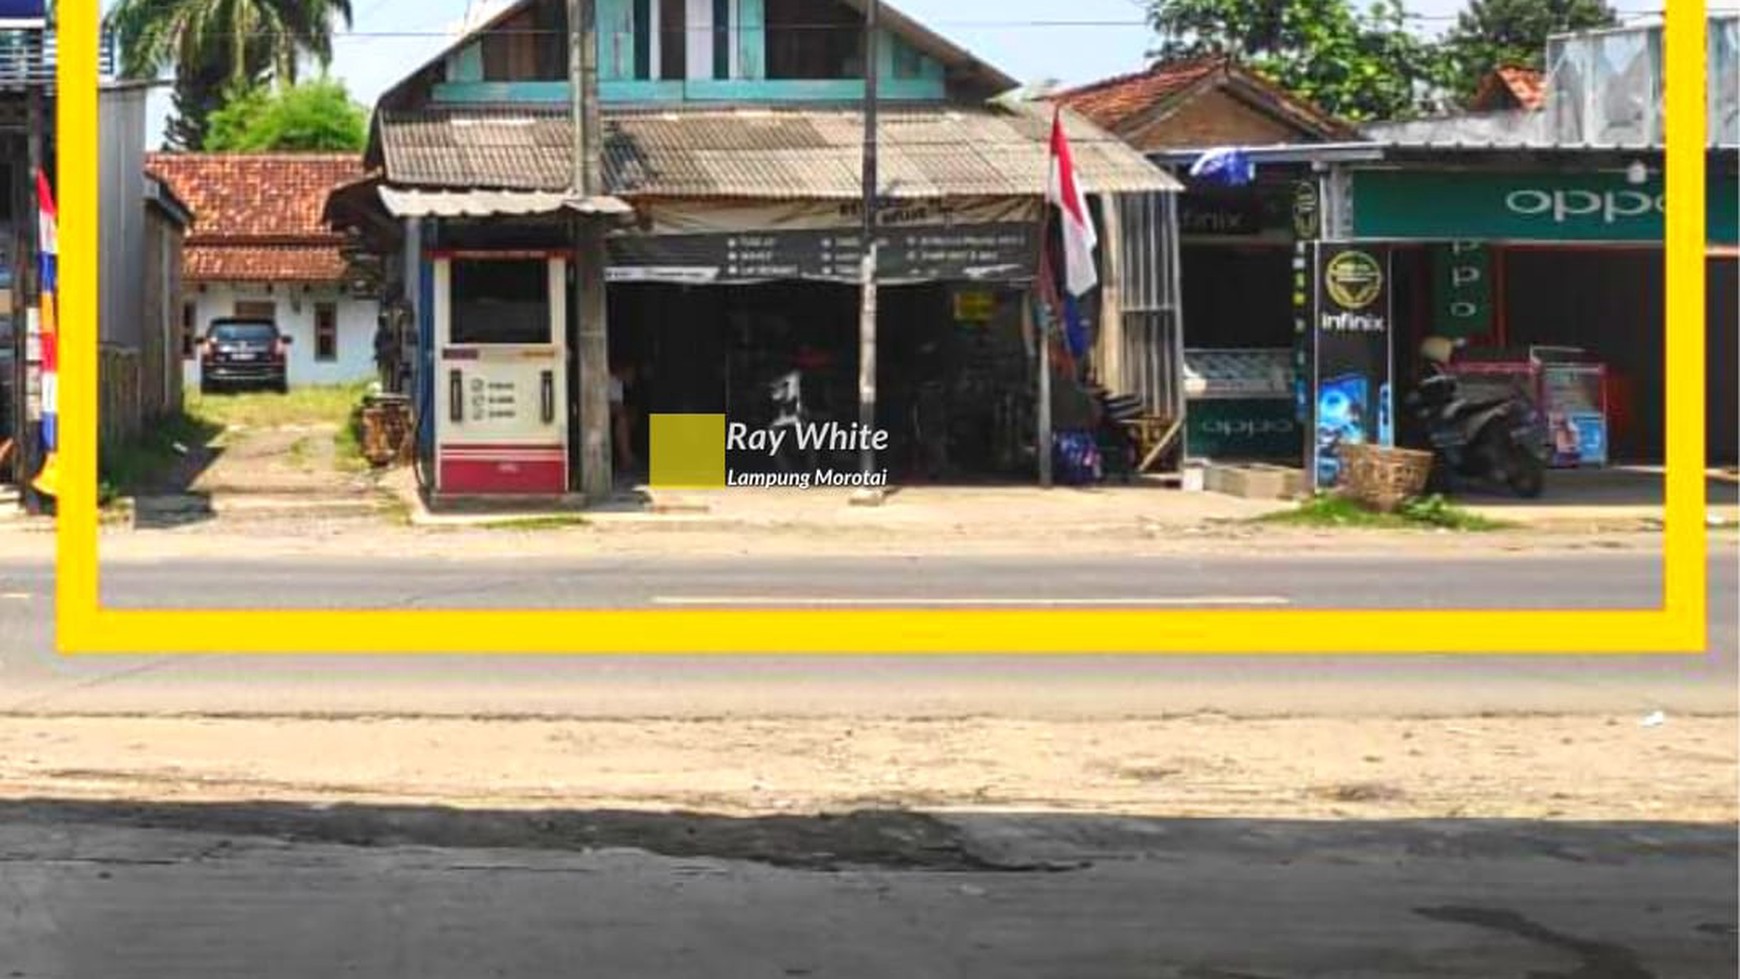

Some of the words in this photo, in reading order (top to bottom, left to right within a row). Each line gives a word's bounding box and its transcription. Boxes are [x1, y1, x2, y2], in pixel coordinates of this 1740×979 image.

[1505, 188, 1666, 223] opp
[1322, 311, 1386, 332] infinix
[1202, 417, 1294, 439] oppo
